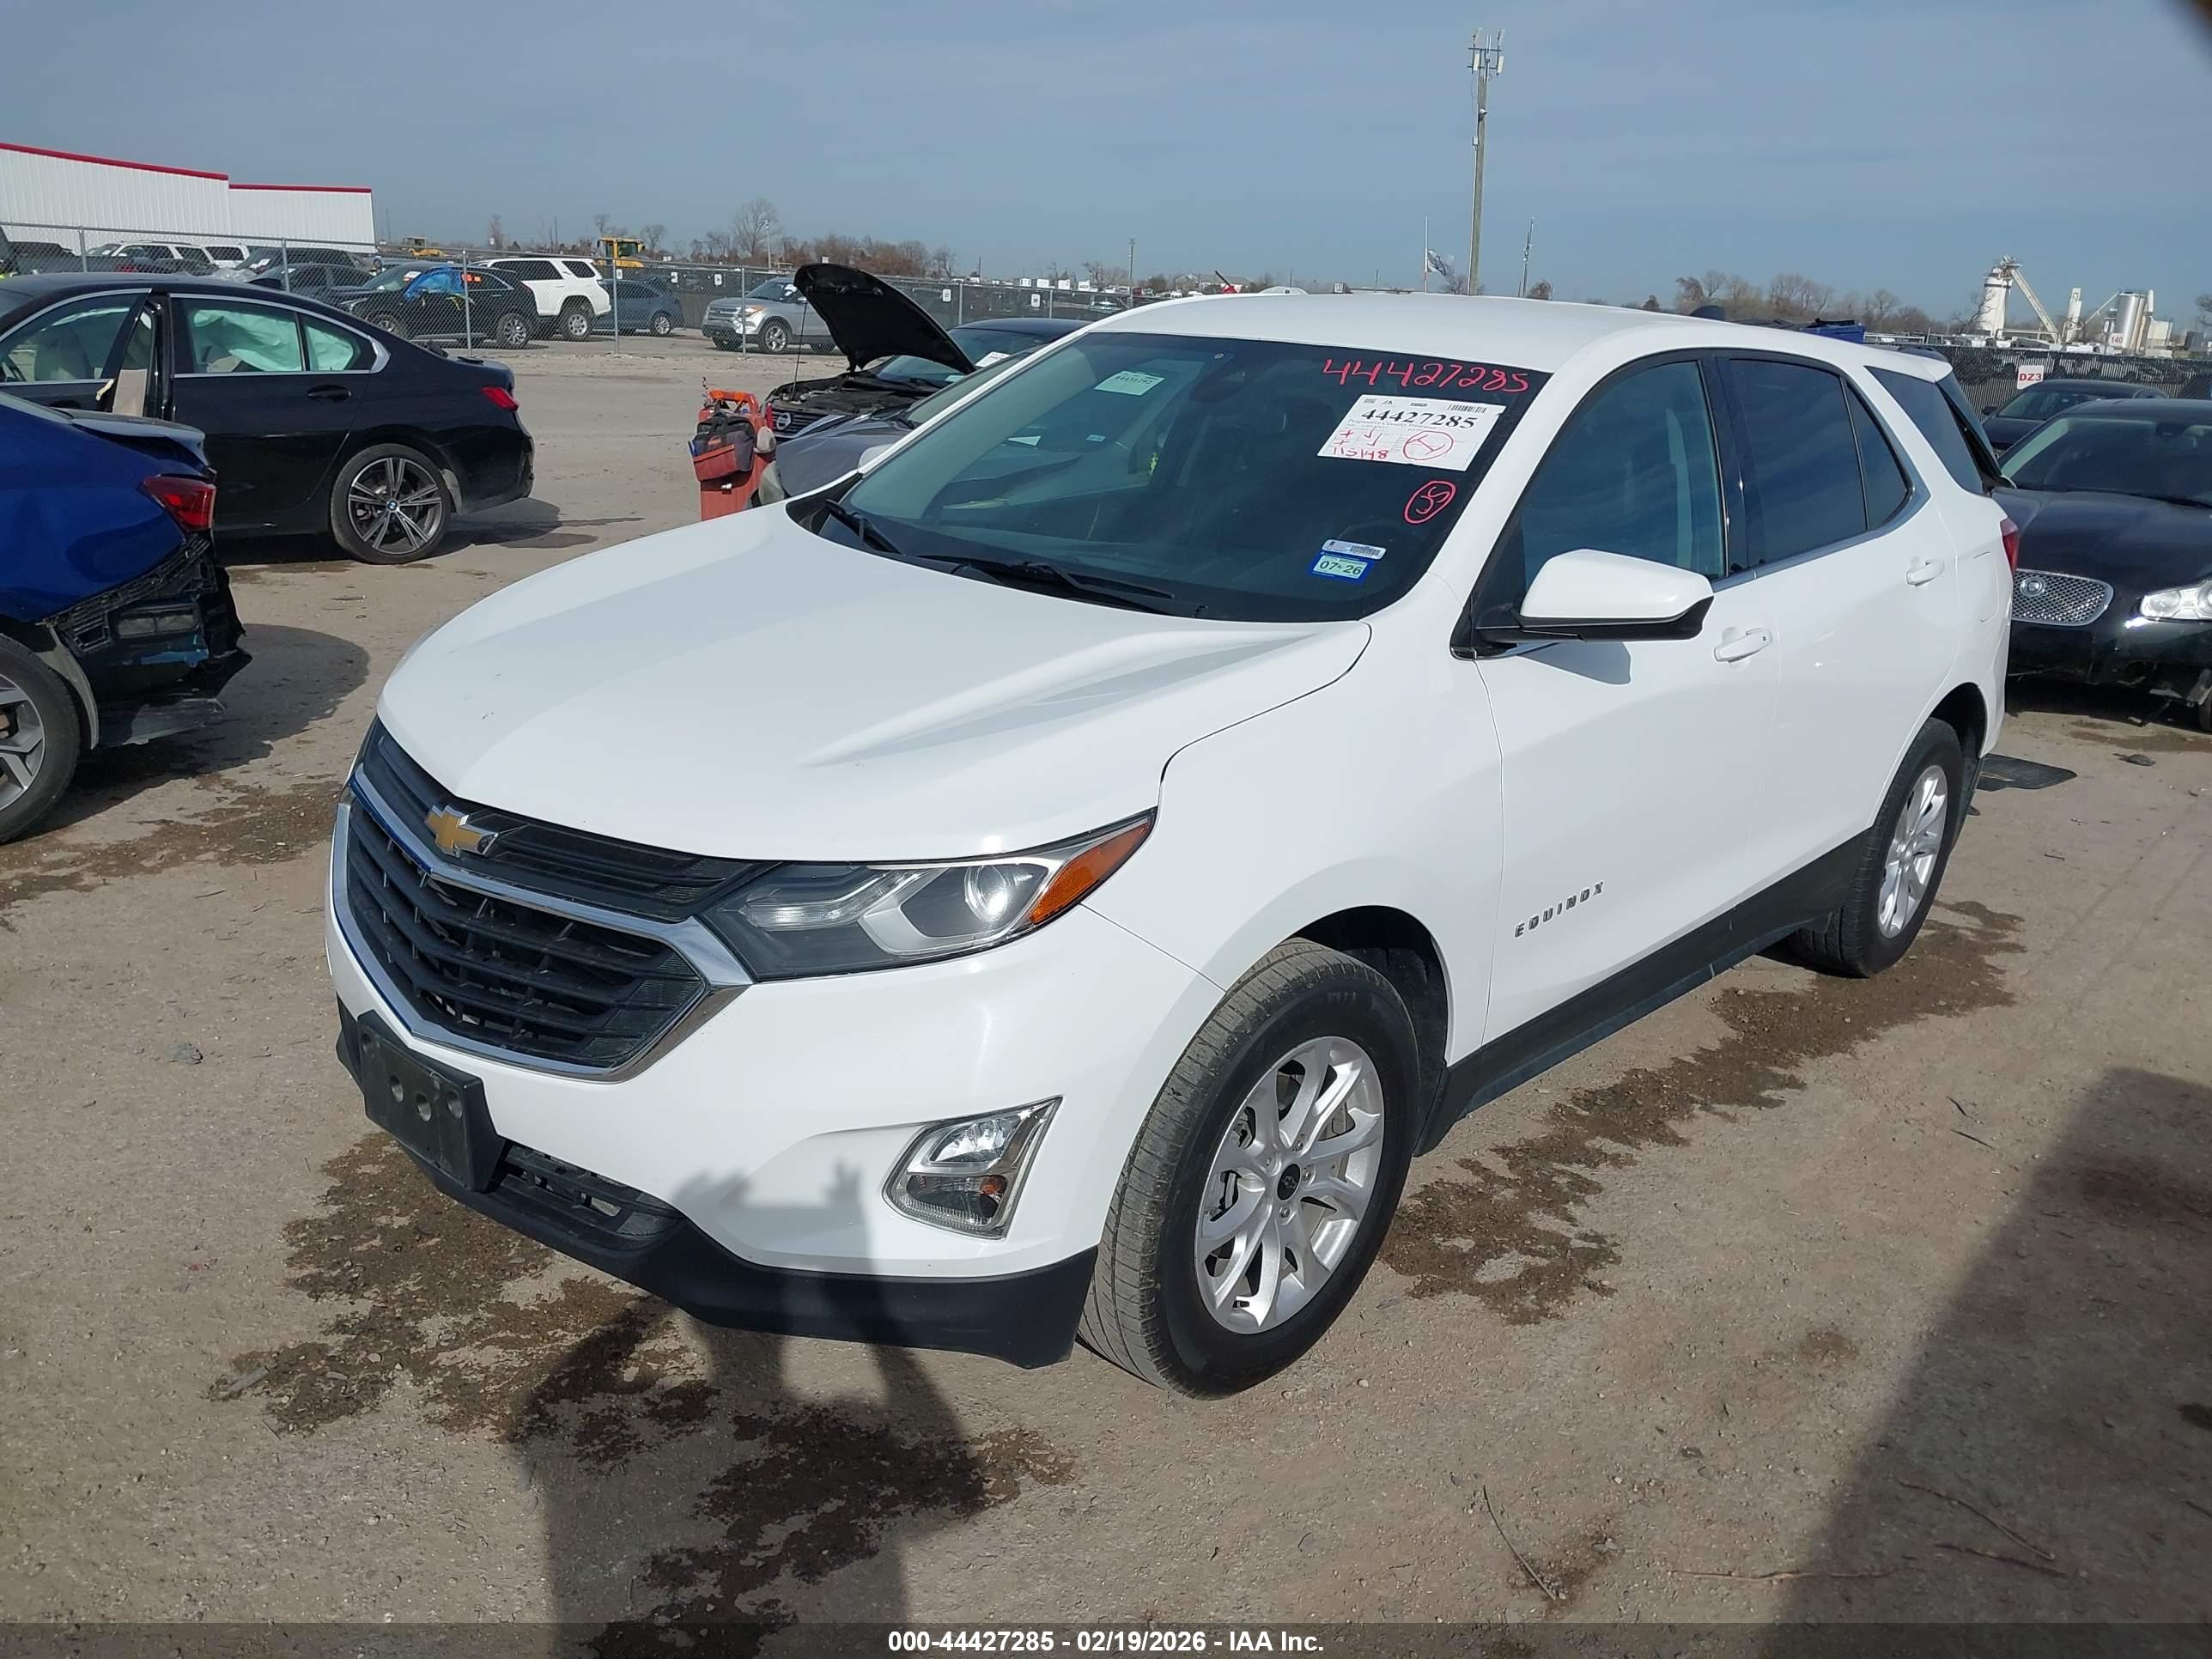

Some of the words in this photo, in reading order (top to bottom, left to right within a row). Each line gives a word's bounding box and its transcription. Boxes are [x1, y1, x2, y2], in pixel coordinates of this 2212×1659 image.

[1322, 359, 1530, 392] 44427285
[2019, 373, 2042, 381] DZ3
[1361, 409, 1479, 428] 44427285
[1515, 881, 1603, 938] EQUINOX
